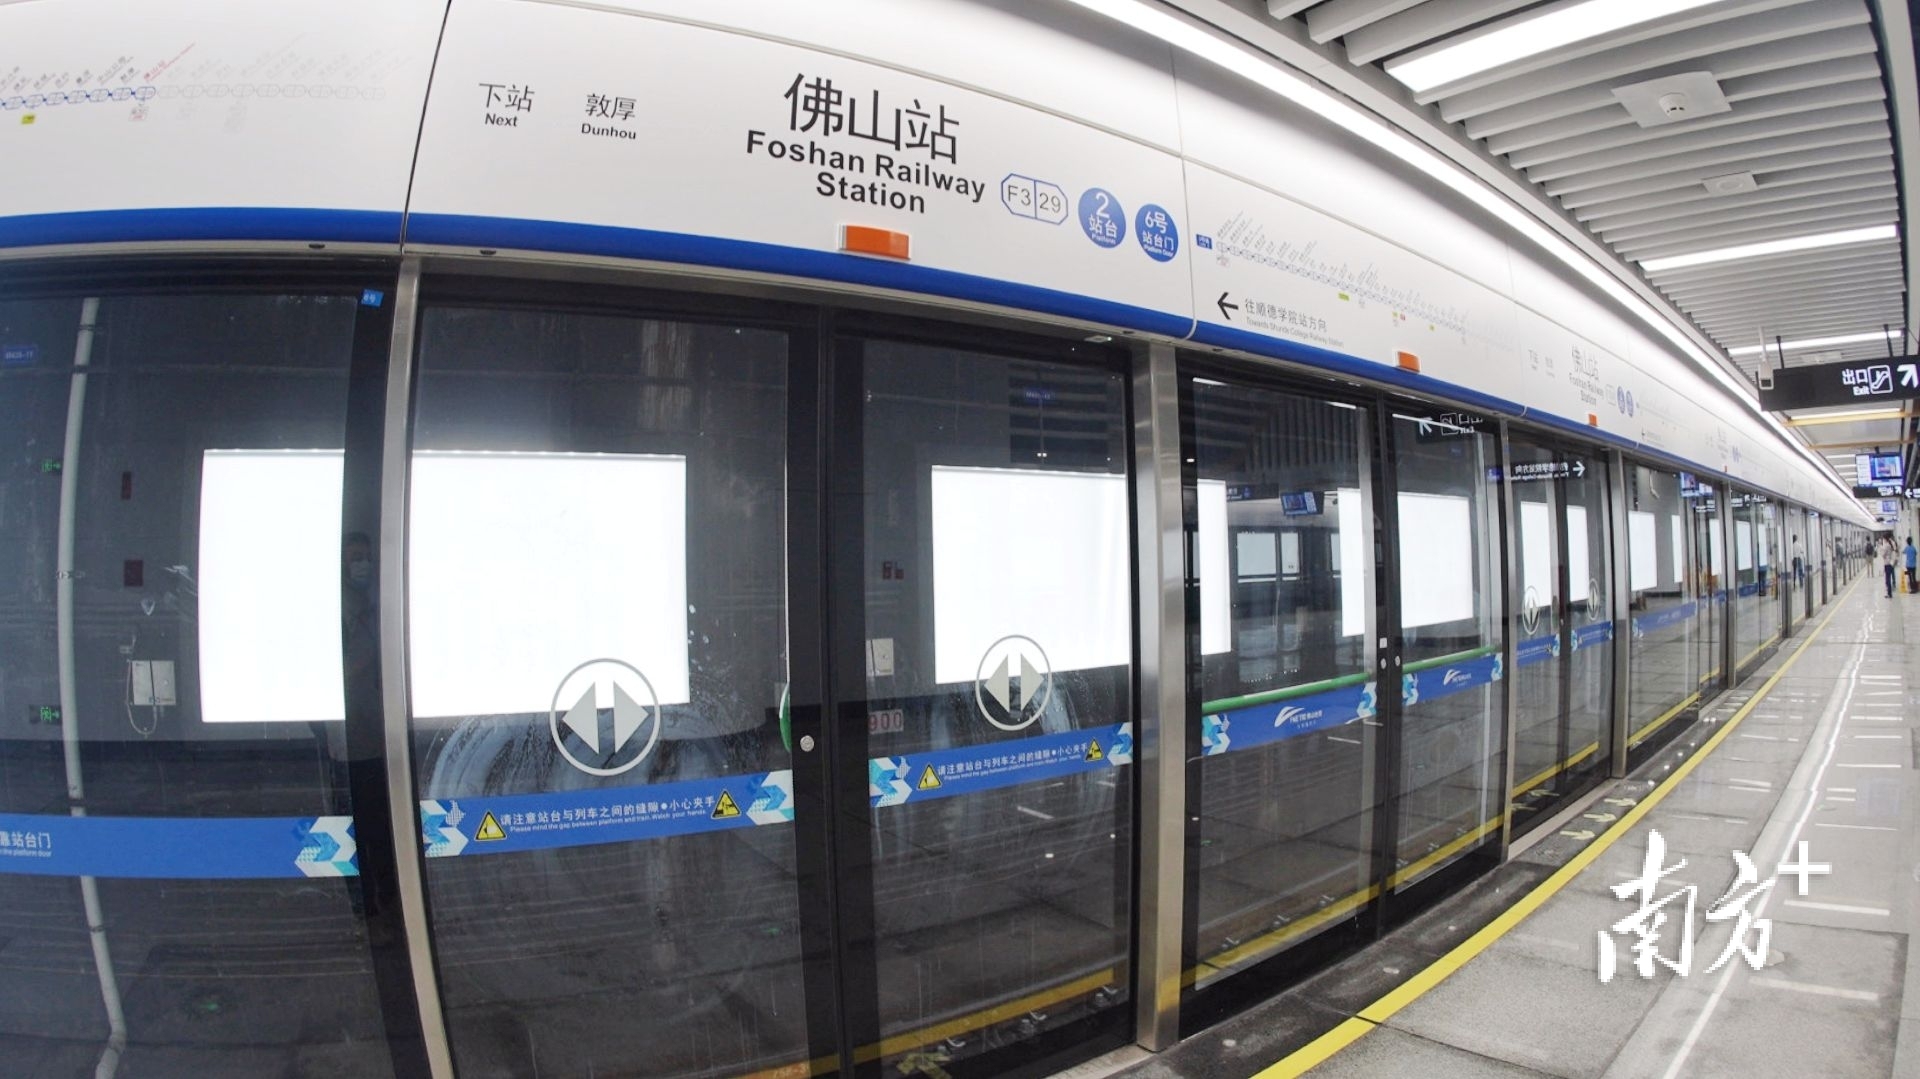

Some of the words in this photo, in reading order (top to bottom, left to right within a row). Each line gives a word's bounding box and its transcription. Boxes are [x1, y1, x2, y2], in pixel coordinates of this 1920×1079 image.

[478, 83, 535, 112] 下站
[585, 93, 637, 121] 敦厚
[485, 112, 518, 127] Next
[581, 122, 637, 140] Dunhou
[784, 72, 960, 165] 佛山站
[747, 129, 865, 174] Foshan
[875, 153, 986, 204] Railway
[816, 171, 925, 214] Station
[1007, 184, 1032, 207] F3
[1039, 192, 1061, 214] 29
[1095, 192, 1110, 219] 2
[1088, 214, 1118, 238] 站台
[1145, 211, 1168, 234] 6号
[1142, 230, 1175, 251] 站台门
[1841, 368, 1868, 385] 出口
[1853, 385, 1870, 396] Exit
